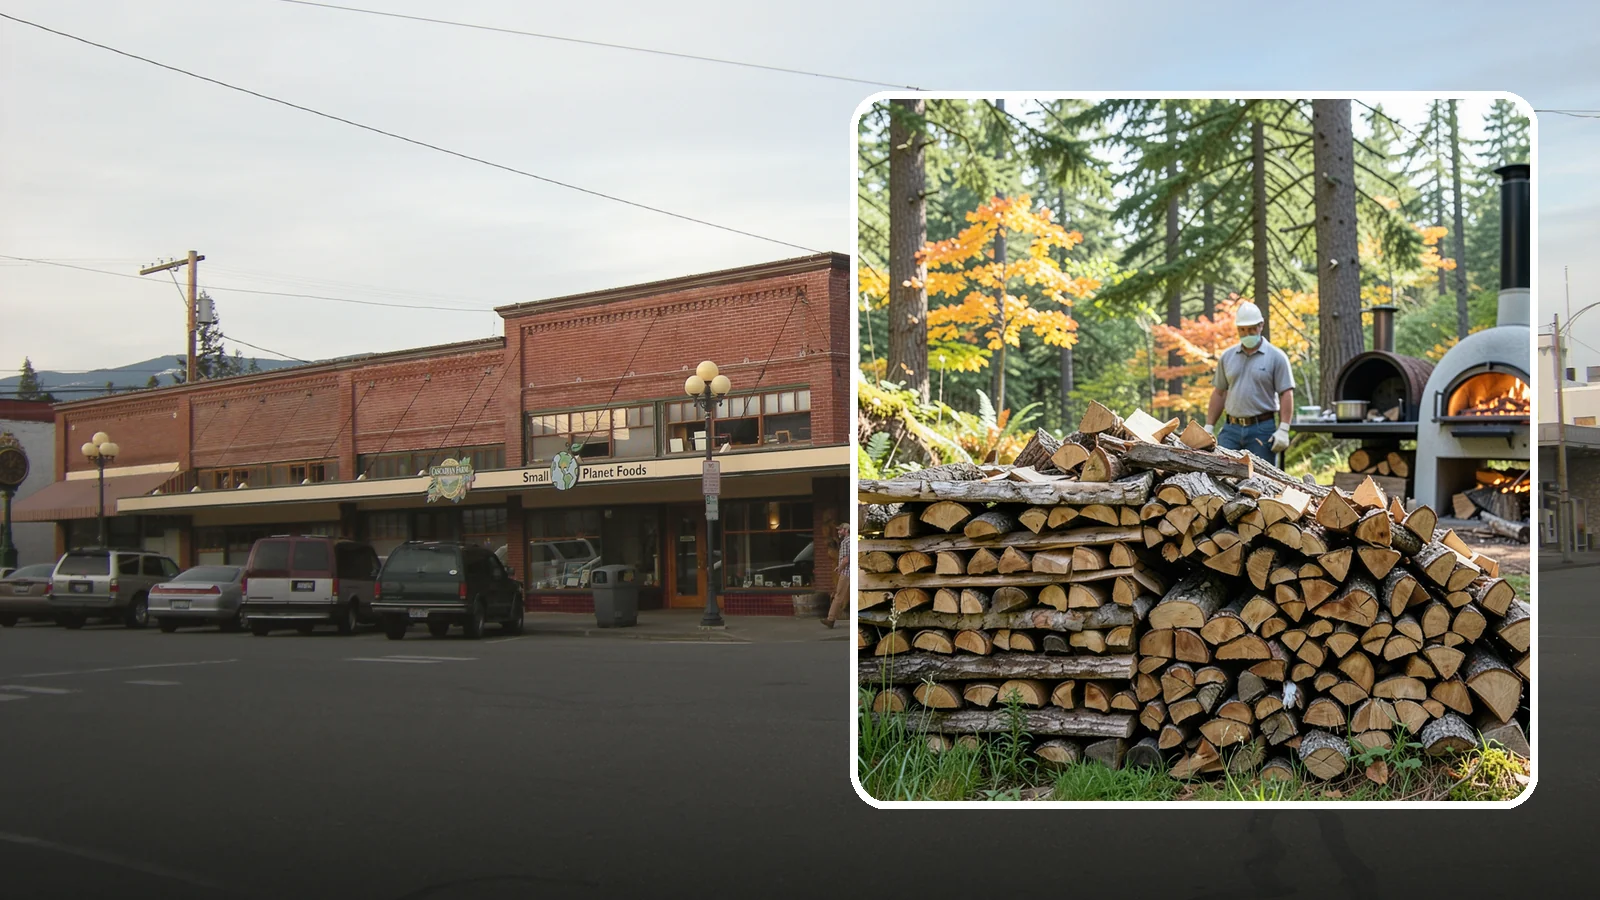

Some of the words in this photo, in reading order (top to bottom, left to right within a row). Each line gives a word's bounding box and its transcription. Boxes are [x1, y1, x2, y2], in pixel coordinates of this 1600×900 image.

[523, 471, 549, 482] Small
[583, 467, 614, 479] Planet
[616, 464, 647, 477] Foods
